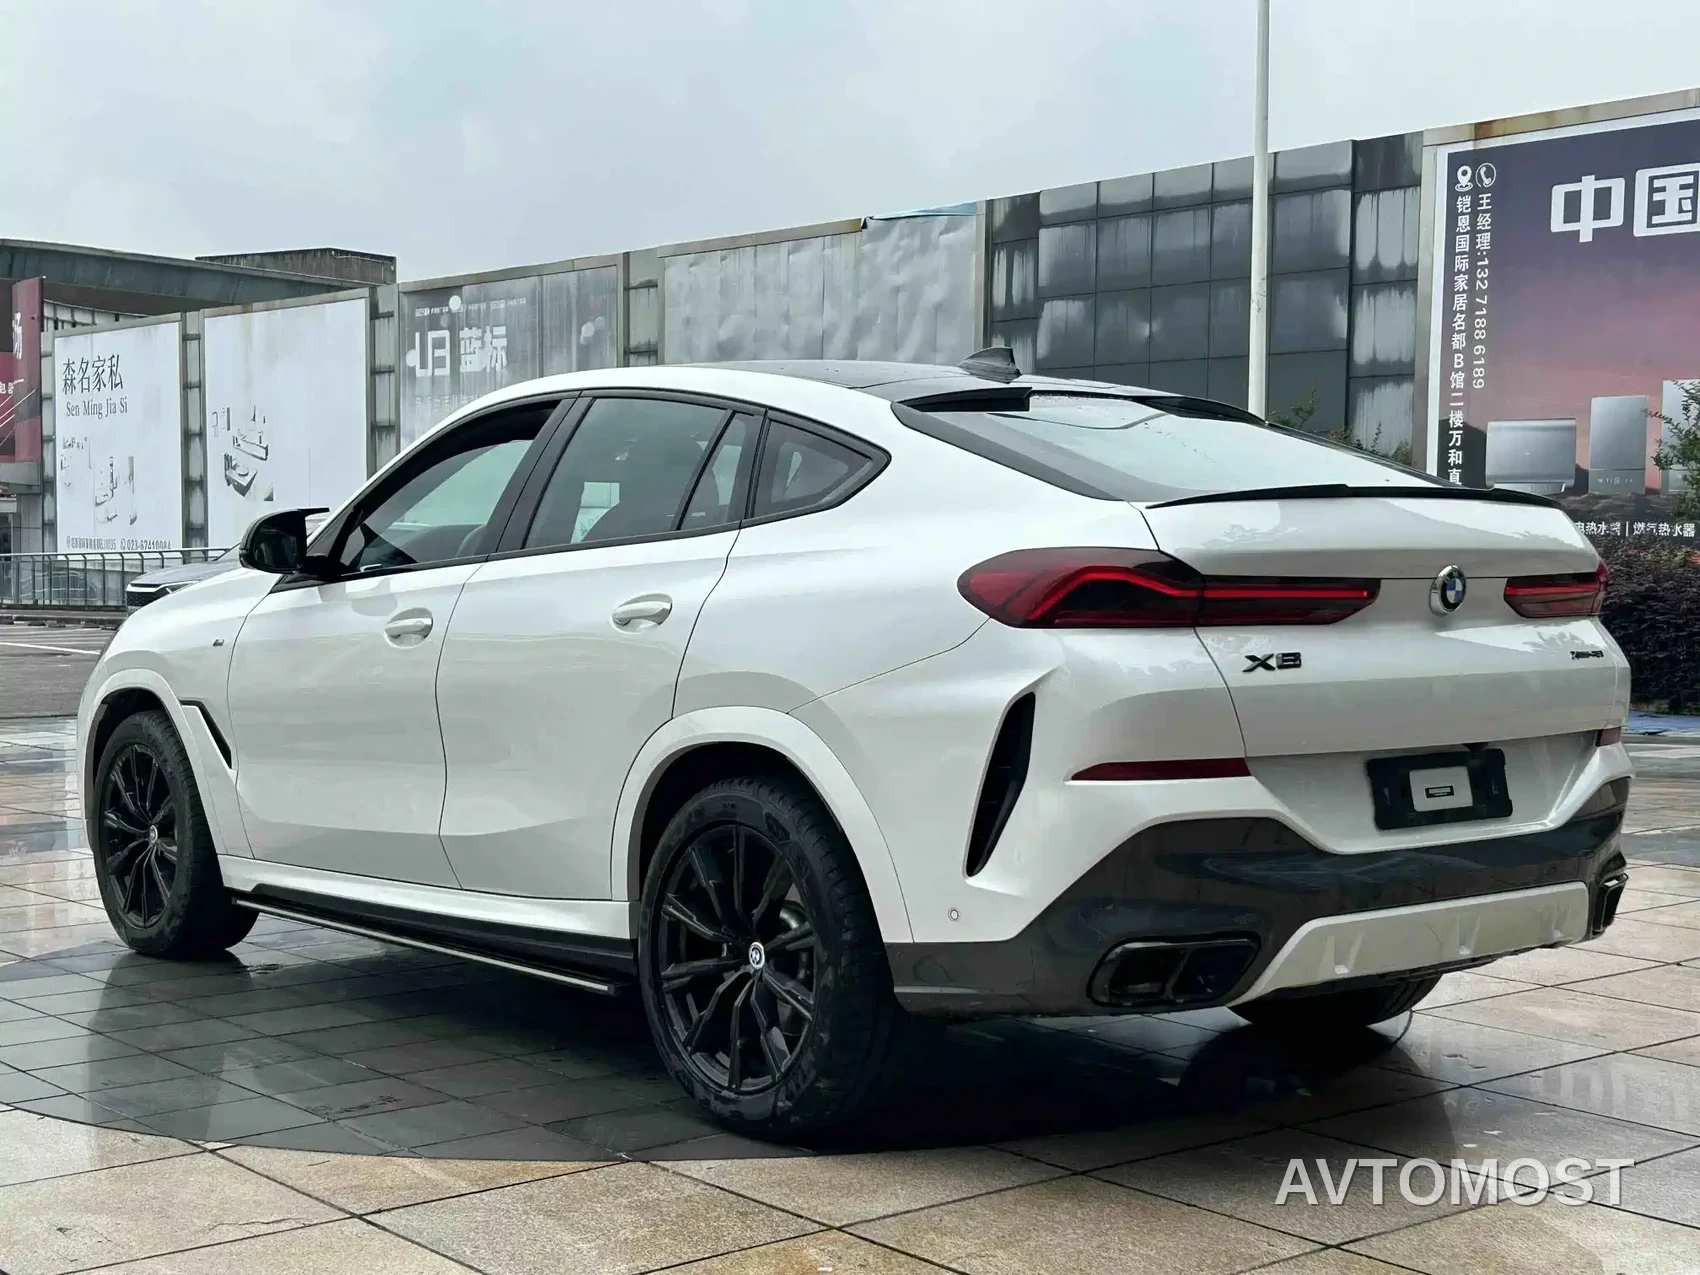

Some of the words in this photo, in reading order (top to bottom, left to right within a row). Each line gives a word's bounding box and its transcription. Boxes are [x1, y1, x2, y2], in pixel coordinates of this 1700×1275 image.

[1550, 162, 1700, 242] 中国
[1474, 295, 1488, 340] 7188
[62, 354, 124, 395] 森名家私
[1472, 345, 1486, 389] 6189
[66, 401, 80, 417] Sen
[83, 399, 103, 420] Ming
[105, 398, 117, 418] Jia
[120, 396, 128, 414] Si
